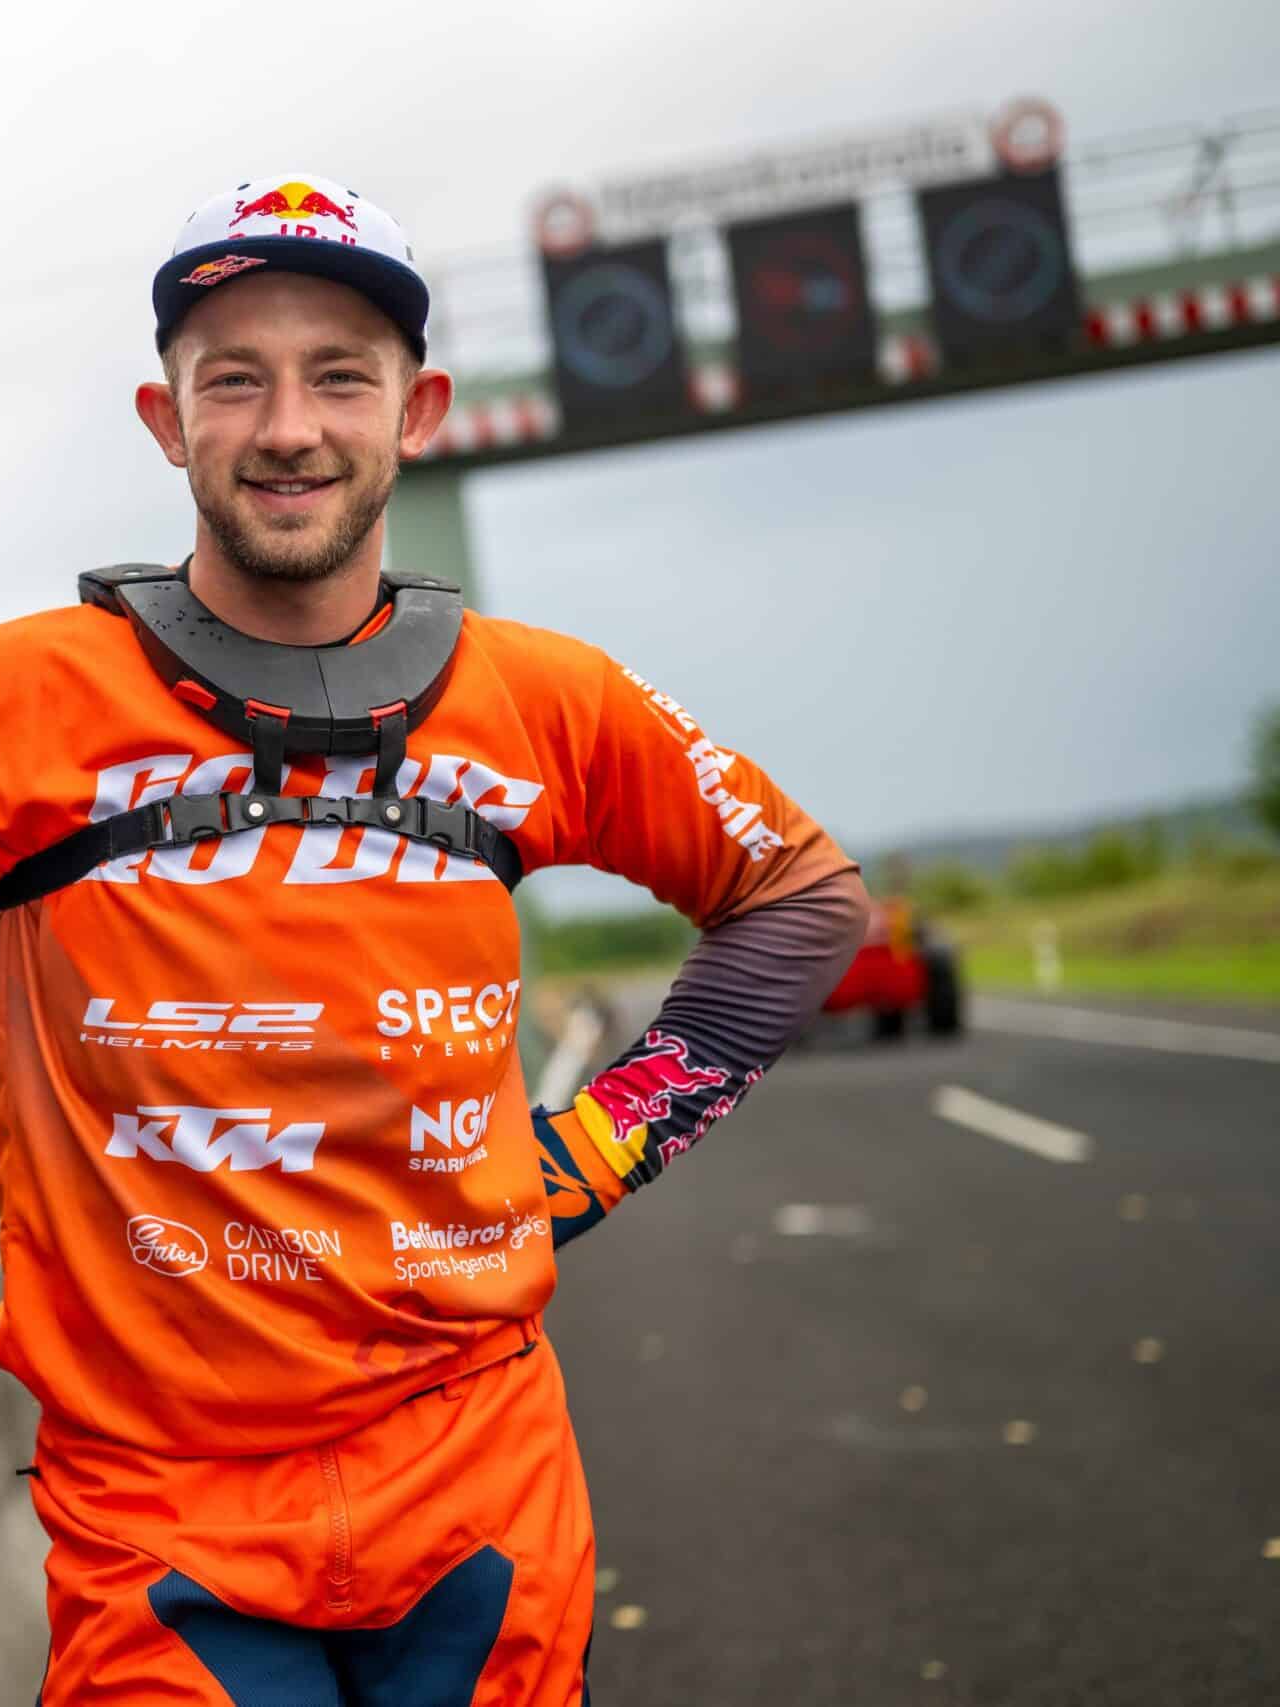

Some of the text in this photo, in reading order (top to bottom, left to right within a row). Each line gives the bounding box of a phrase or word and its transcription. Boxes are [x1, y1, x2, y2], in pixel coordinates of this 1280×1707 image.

[82, 997, 326, 1033] LS2
[376, 979, 521, 1038] SPECT
[79, 1031, 314, 1052] HELMETS
[103, 1104, 327, 1173] KTM
[223, 1221, 343, 1258] CARBON
[226, 1253, 324, 1282] DRIVE
[393, 1249, 508, 1289] Sports Agency
